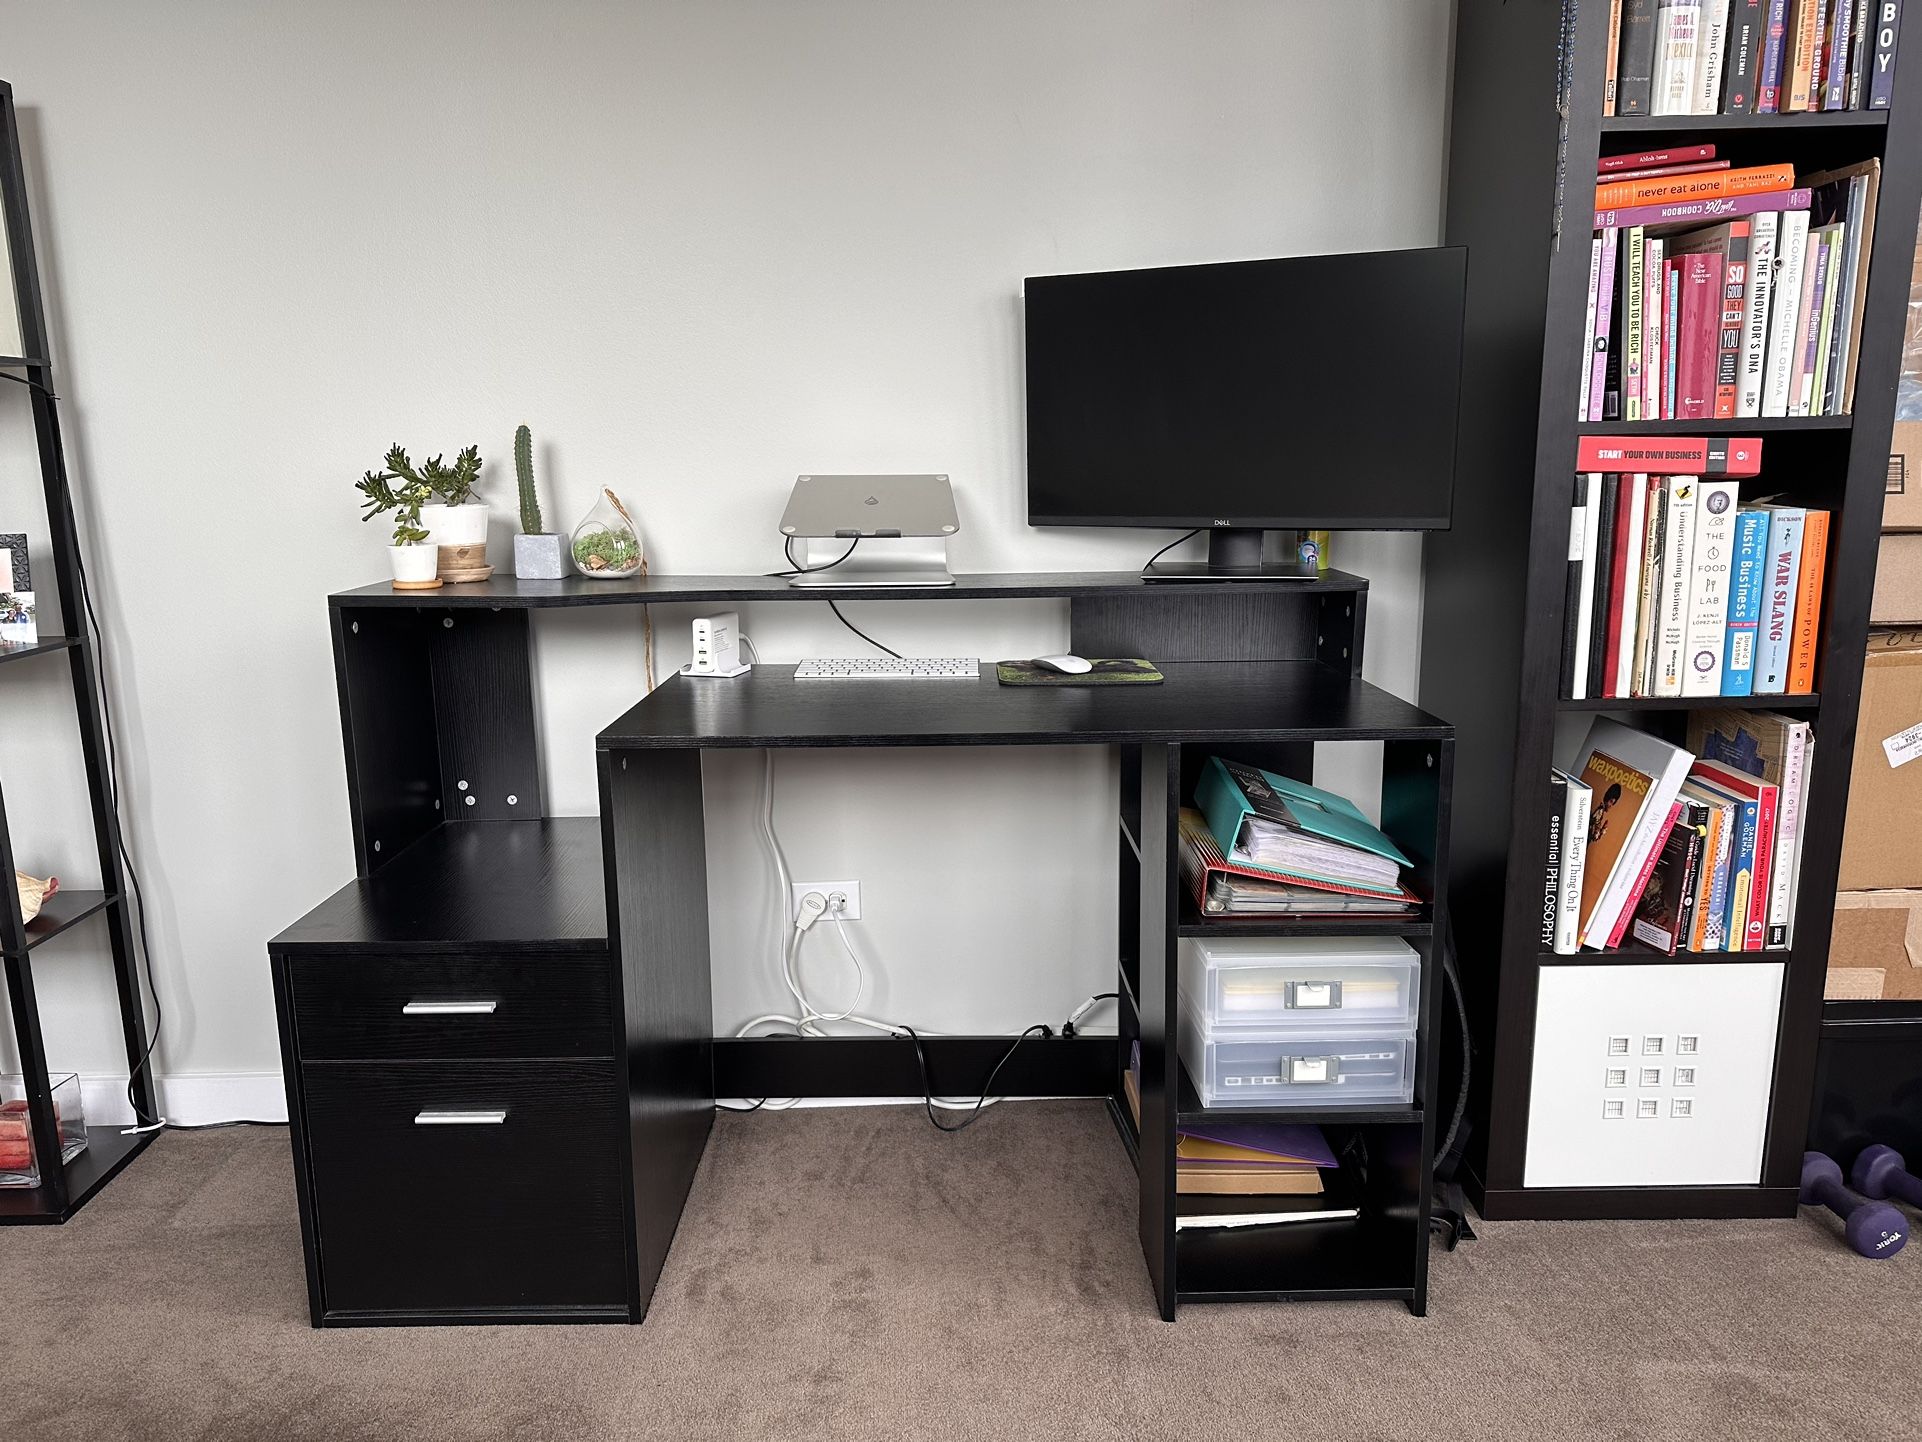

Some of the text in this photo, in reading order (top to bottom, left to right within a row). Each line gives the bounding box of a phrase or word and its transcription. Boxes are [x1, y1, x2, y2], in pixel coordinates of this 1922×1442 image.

[1774, 2, 1784, 21] RICH
[1710, 24, 1721, 49] John
[1840, 10, 1851, 58] SMOOTHIE
[1857, 10, 1865, 43] BREATHED
[1878, 3, 1897, 73] BOY
[1738, 25, 1750, 76] BRIAN COLEMAN
[1801, 22, 1814, 72] EXPEDITION
[1812, 6, 1826, 90] FERTILE GROUND
[1705, 52, 1718, 98] Grisham
[1768, 70, 1777, 83] HILL
[1836, 58, 1846, 82] Bible
[1638, 186, 1667, 198] never
[1670, 185, 1688, 194] eat
[1690, 182, 1720, 192] alone
[1662, 206, 1703, 217] COOKBOOK
[1632, 239, 1640, 260] WILL
[1590, 269, 1598, 293] AMAZING
[1632, 262, 1640, 287] TEACH
[1729, 266, 1744, 283] SO
[1632, 289, 1640, 308] YOU
[1727, 285, 1743, 299] GOOD
[1631, 309, 1640, 319] TO
[1726, 301, 1741, 311] THEY
[1726, 312, 1740, 320] CAN'T
[1748, 258, 1769, 374] THE INNOVATOR'S DNA
[1776, 225, 1801, 396] BECOMING MICHELLE OBAMA
[1631, 321, 1640, 332] BE
[1808, 309, 1821, 342] inGenius
[1630, 334, 1639, 354] RICH
[1723, 330, 1739, 348] YOU
[1598, 450, 1702, 460] START YOUR OWN BUSINESS
[1672, 512, 1688, 622] Understanding Business
[1736, 519, 1757, 618] Music Business
[1700, 597, 1720, 605] LAB
[1751, 587, 1759, 605] About
[1769, 551, 1792, 641] WAR SLANG
[1743, 635, 1751, 659] Donald
[1800, 620, 1812, 669] POWER
[1588, 756, 1649, 796] waxpoetics
[1791, 746, 1799, 784] DREAM
[1578, 797, 1587, 830] Silverstein
[1786, 792, 1794, 830] LOGIC
[1660, 828, 1669, 838] The
[1741, 822, 1750, 858] GOLEMAN
[1746, 827, 1755, 853] DANIEL
[1761, 821, 1769, 856] PARACHUTE?
[1570, 836, 1585, 861] Every
[1650, 838, 1666, 861] Ultimate
[1542, 816, 1560, 946] essential PHILOSOPHY
[1567, 861, 1582, 888] Thing
[1686, 871, 1696, 896] Dreaming
[1568, 890, 1579, 905] On
[1700, 897, 1709, 911] YES
[1777, 884, 1786, 918] MACK
[1733, 875, 1747, 947] Emotional Intelligence
